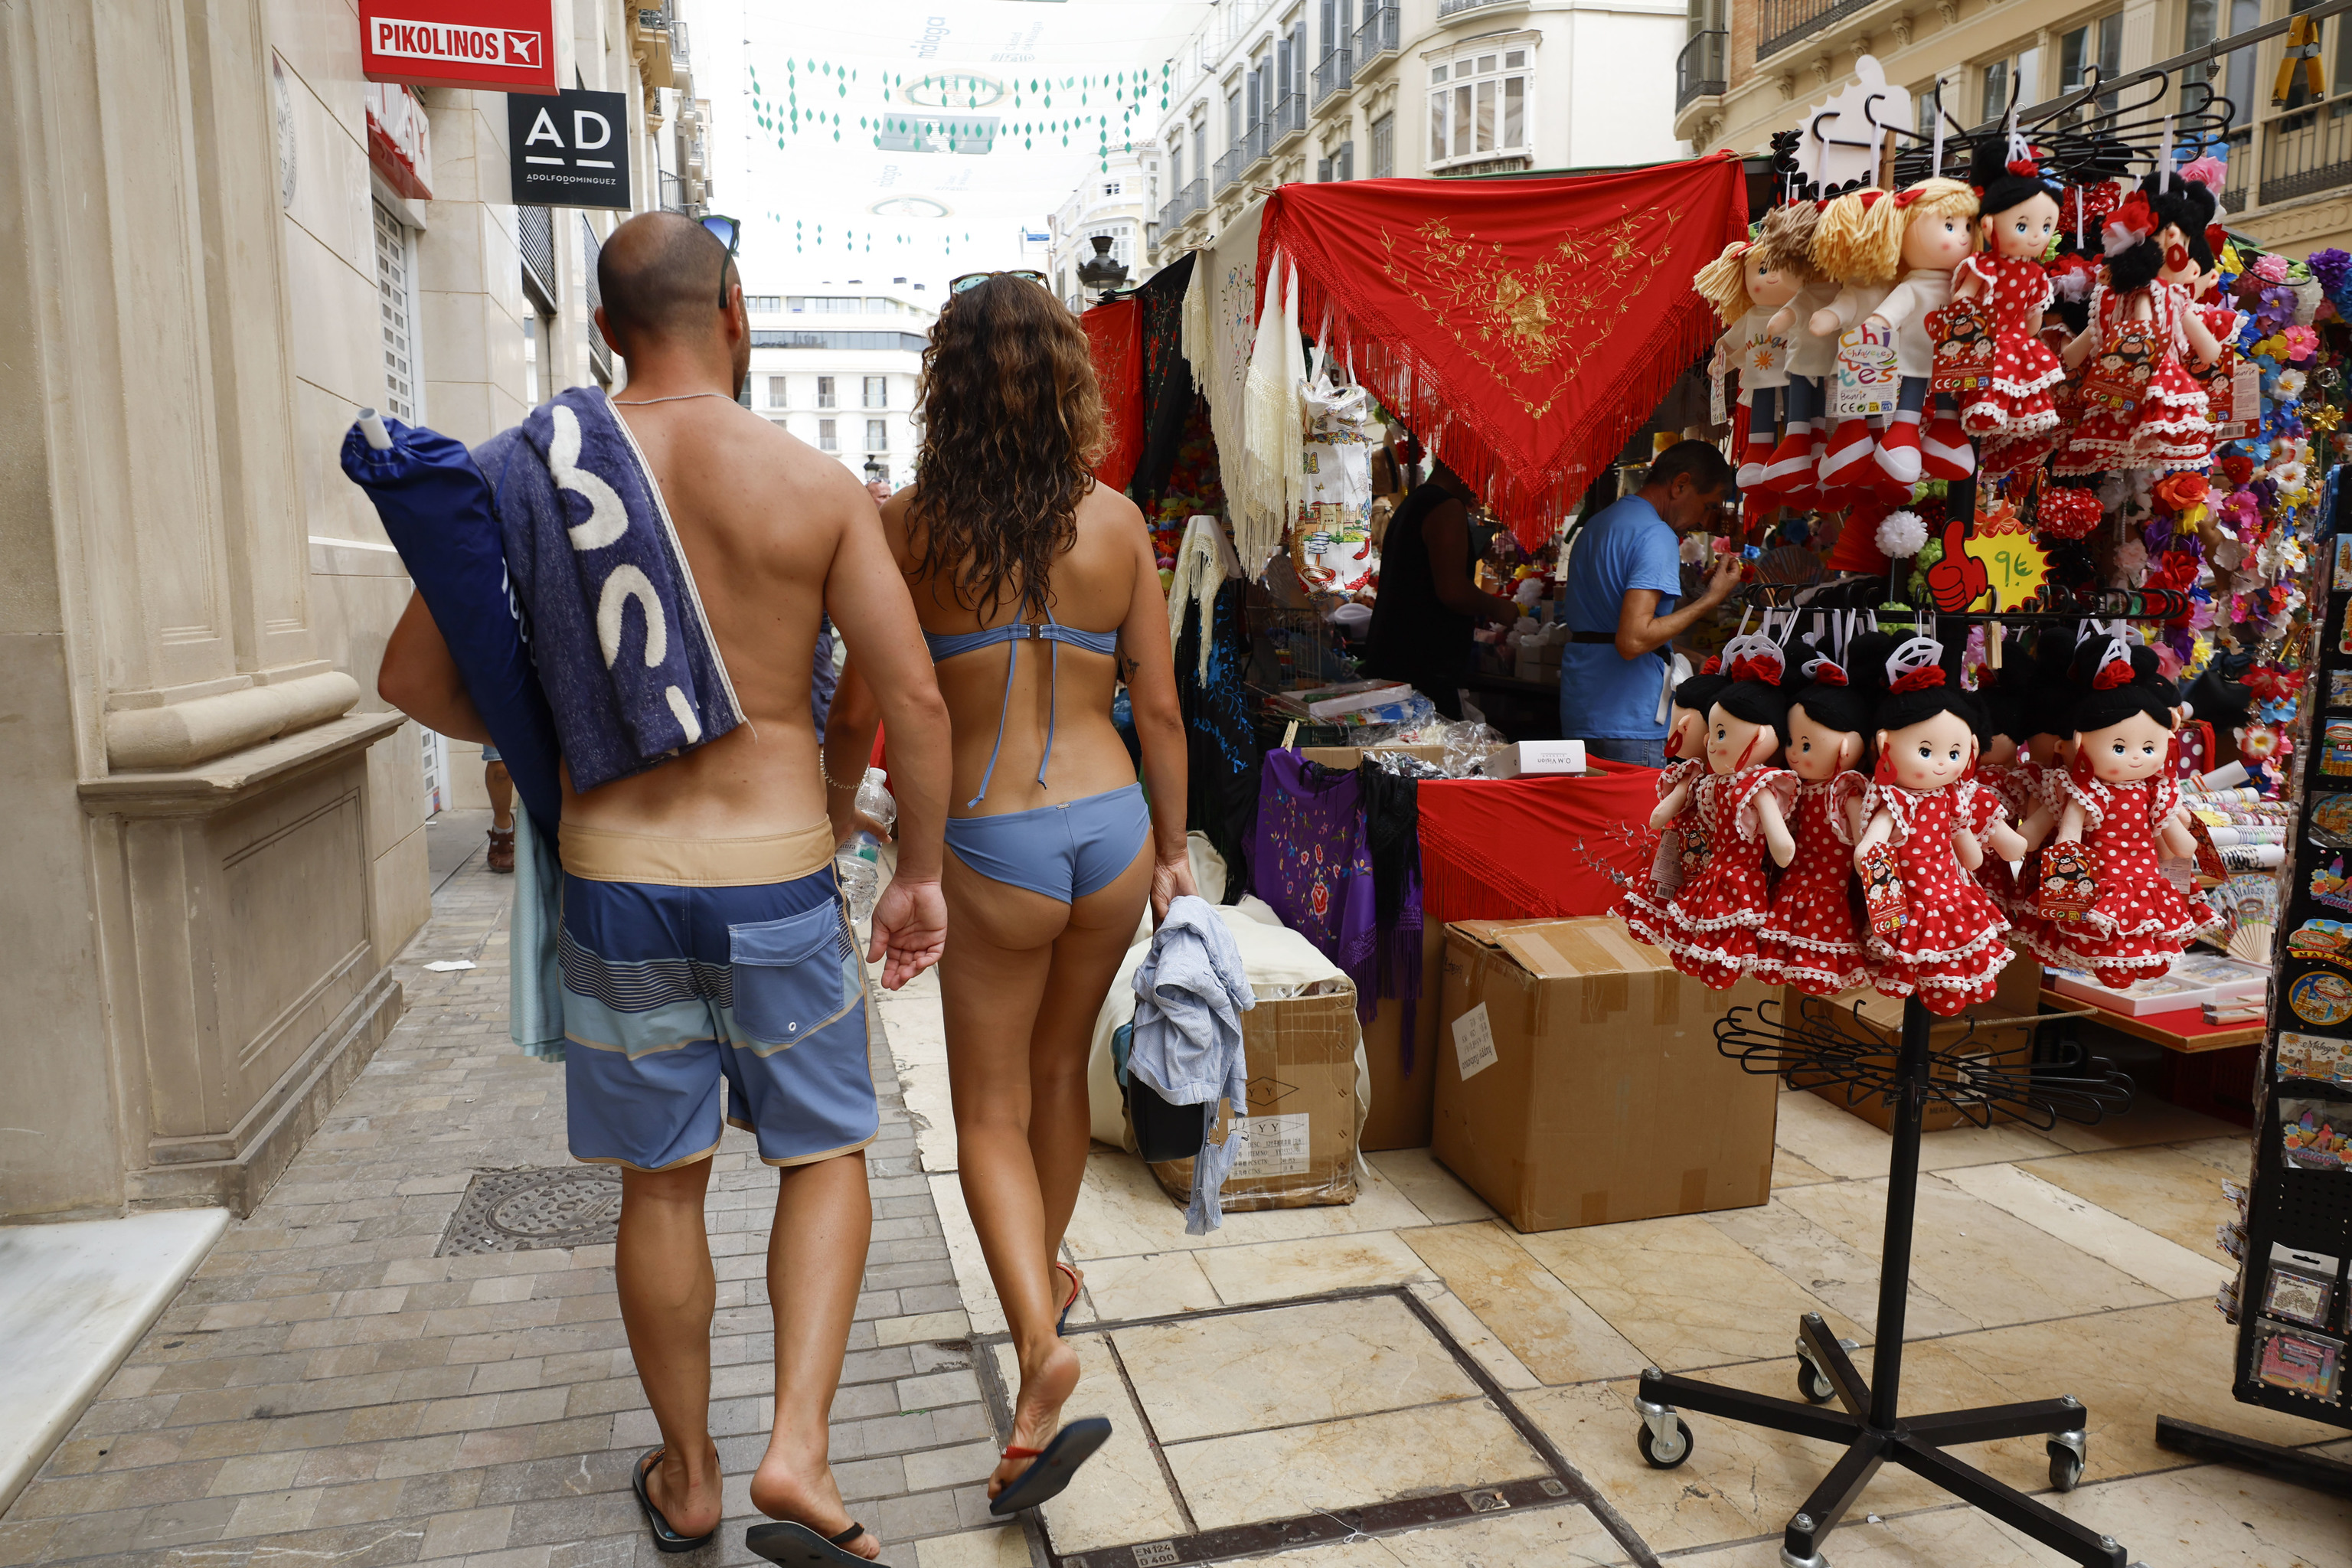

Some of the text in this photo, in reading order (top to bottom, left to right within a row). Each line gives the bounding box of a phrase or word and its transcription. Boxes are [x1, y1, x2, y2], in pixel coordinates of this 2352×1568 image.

[378, 23, 499, 60] PIKOLINOS
[526, 173, 616, 185] ADOLFODOMINGUEZ
[2041, 908, 2056, 918] CE
[1874, 921, 1886, 933] CE
[1248, 1087, 1272, 1097] Y Y
[1259, 1123, 1279, 1133] Y Y
[1151, 1553, 1174, 1563] 400
